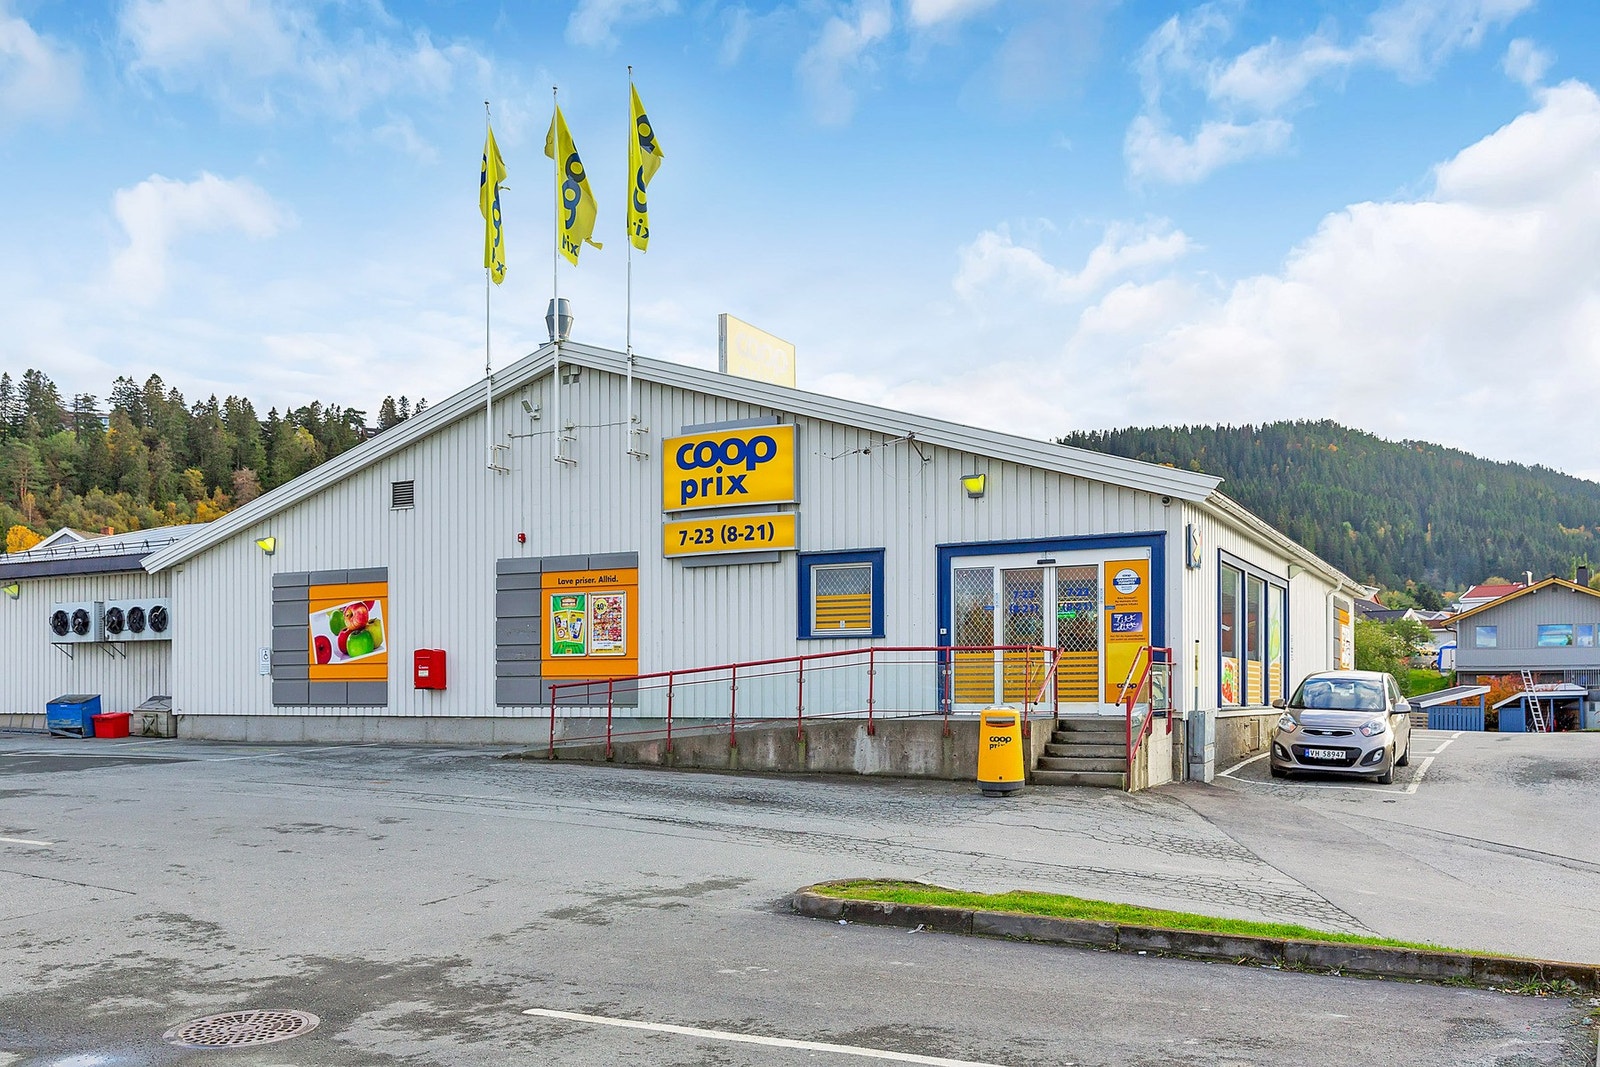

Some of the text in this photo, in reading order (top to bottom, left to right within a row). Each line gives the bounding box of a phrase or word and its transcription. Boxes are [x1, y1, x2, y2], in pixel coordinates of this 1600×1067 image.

[676, 435, 777, 471] coop
[681, 465, 748, 505] prix
[679, 522, 774, 546] 7-23 (8-21)
[575, 577, 596, 586] priser.
[598, 575, 618, 583] Alltid.
[989, 736, 1012, 744] coop
[1323, 750, 1345, 758] 58947
